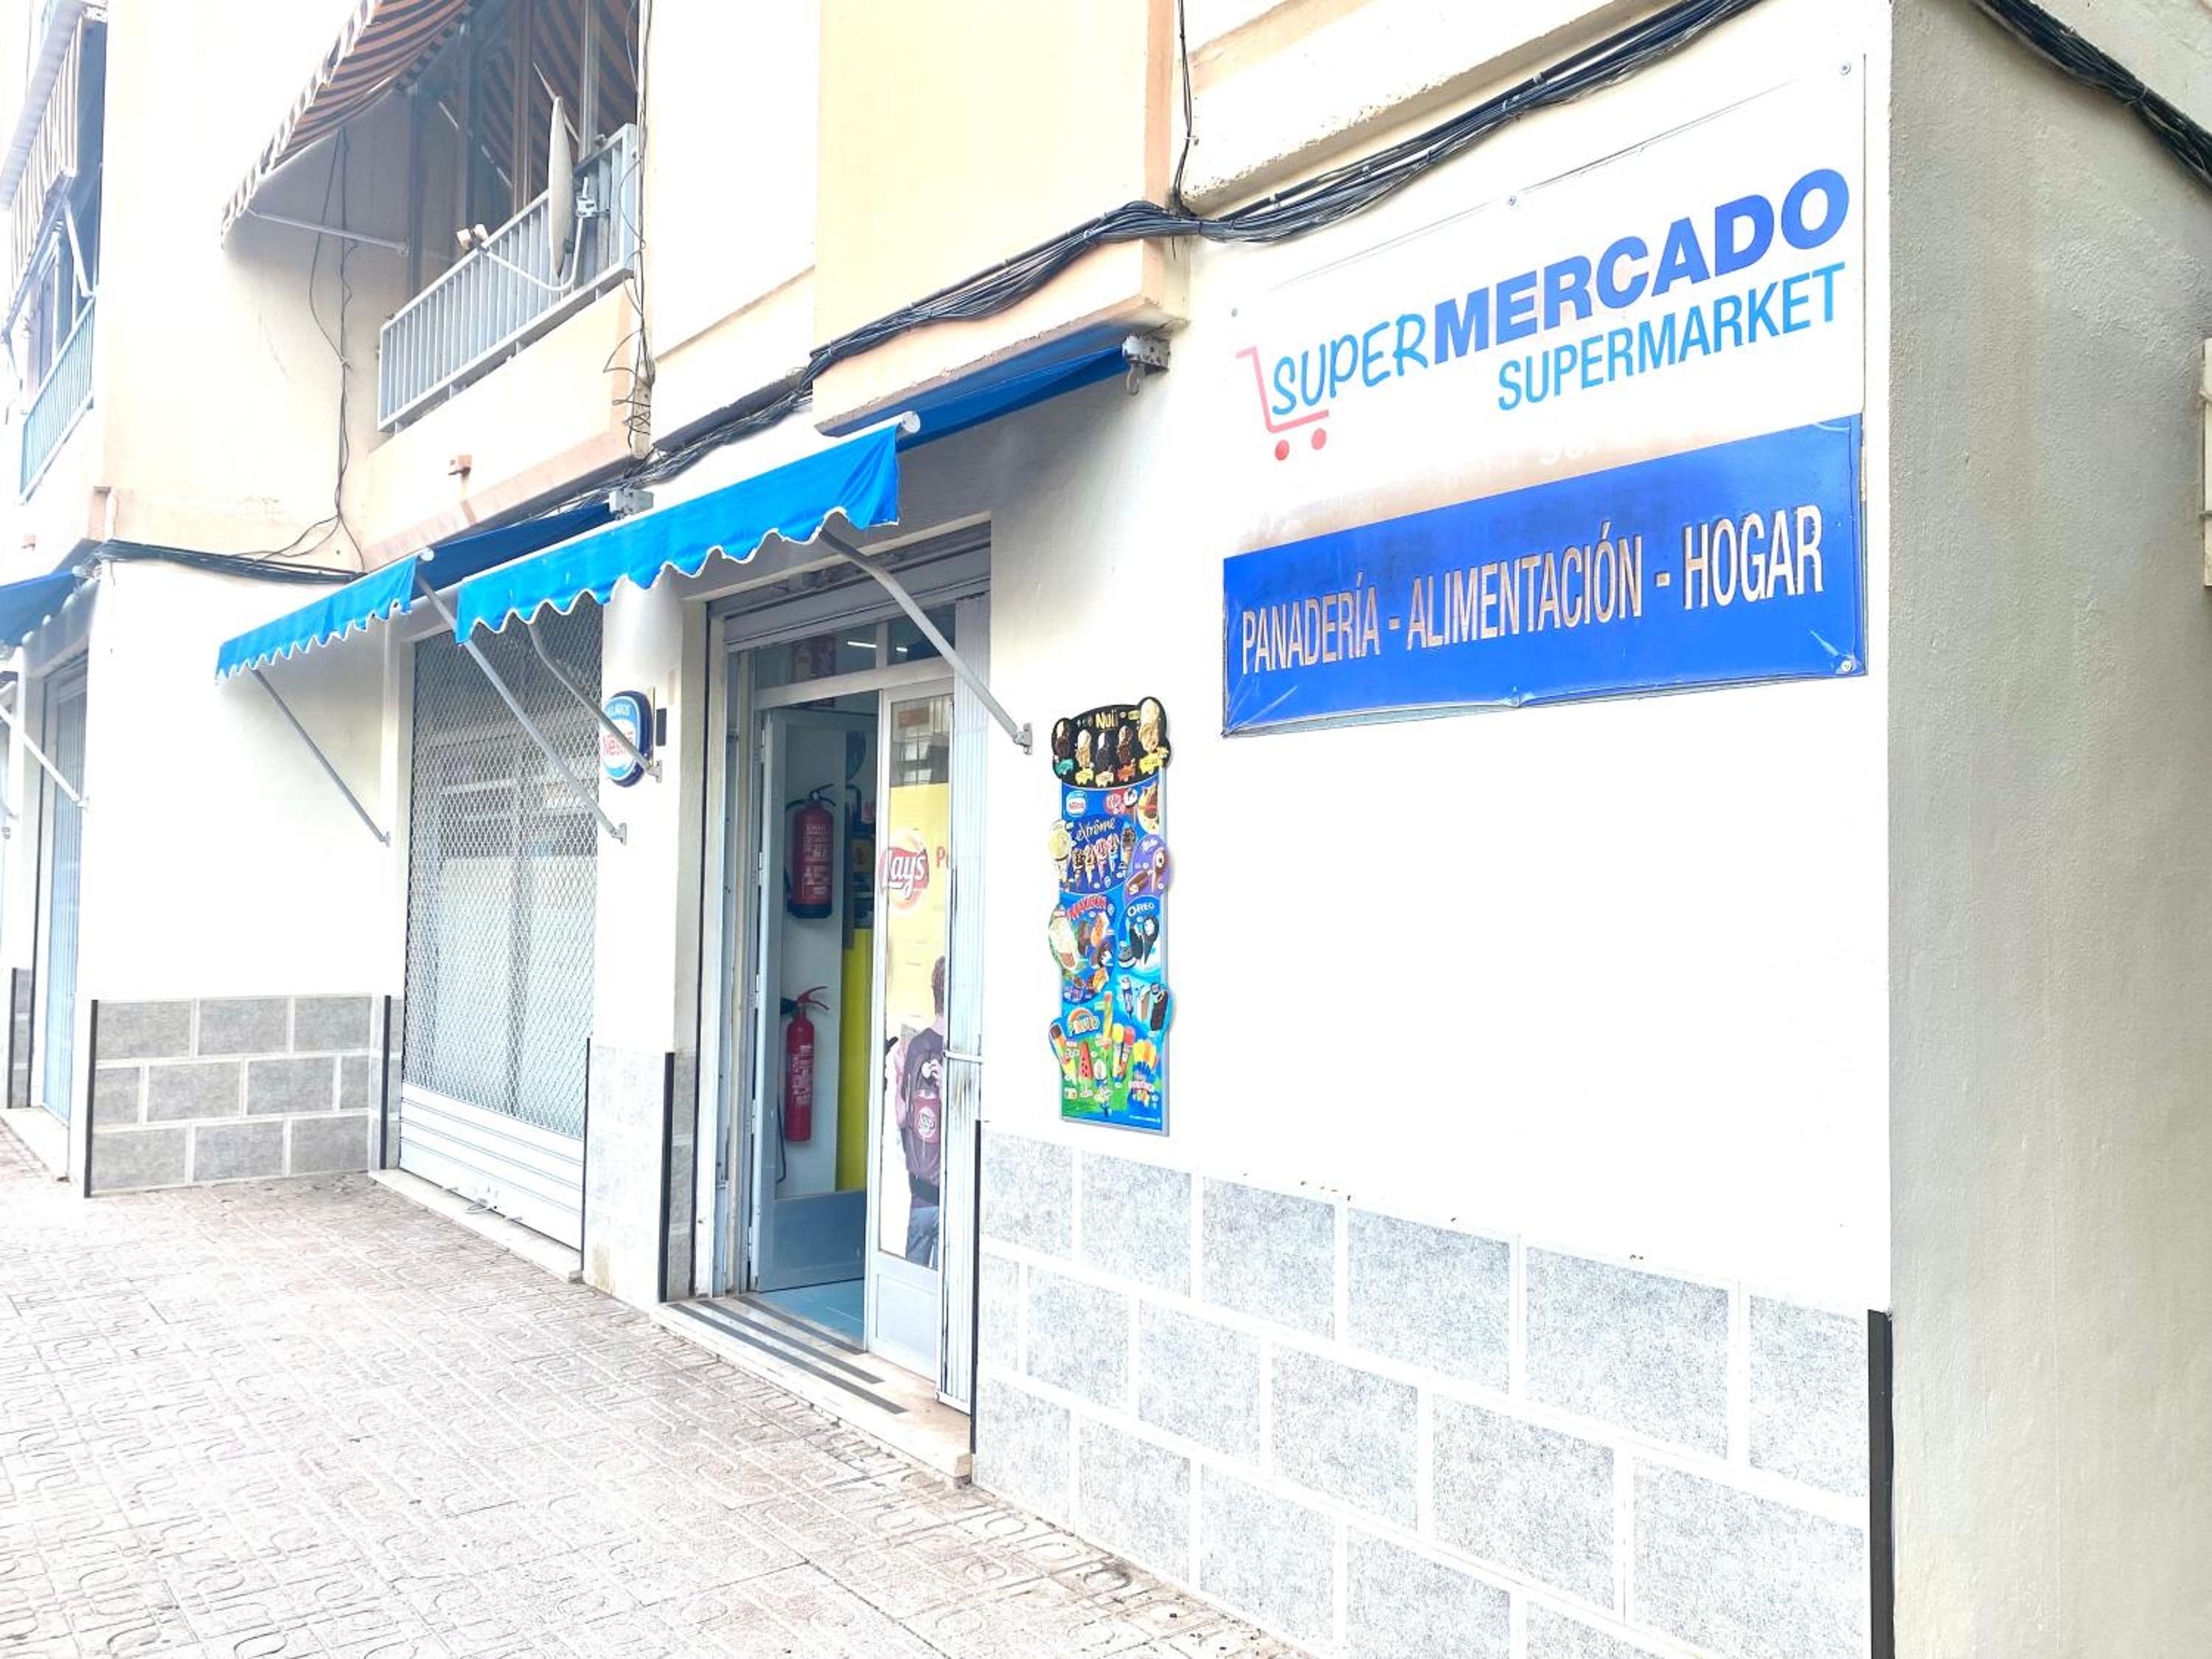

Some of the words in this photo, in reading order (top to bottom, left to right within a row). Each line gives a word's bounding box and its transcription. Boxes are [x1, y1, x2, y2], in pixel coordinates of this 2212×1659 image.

[1271, 169, 1850, 415] SUPERMERCADO
[1498, 262, 1846, 411] SUPERMARKET
[1242, 571, 1380, 675] PANADERÍA
[1406, 521, 1643, 650] ALIMENTACIÓN
[1684, 504, 1824, 610] HOGAR
[1127, 902, 1155, 917] OREO
